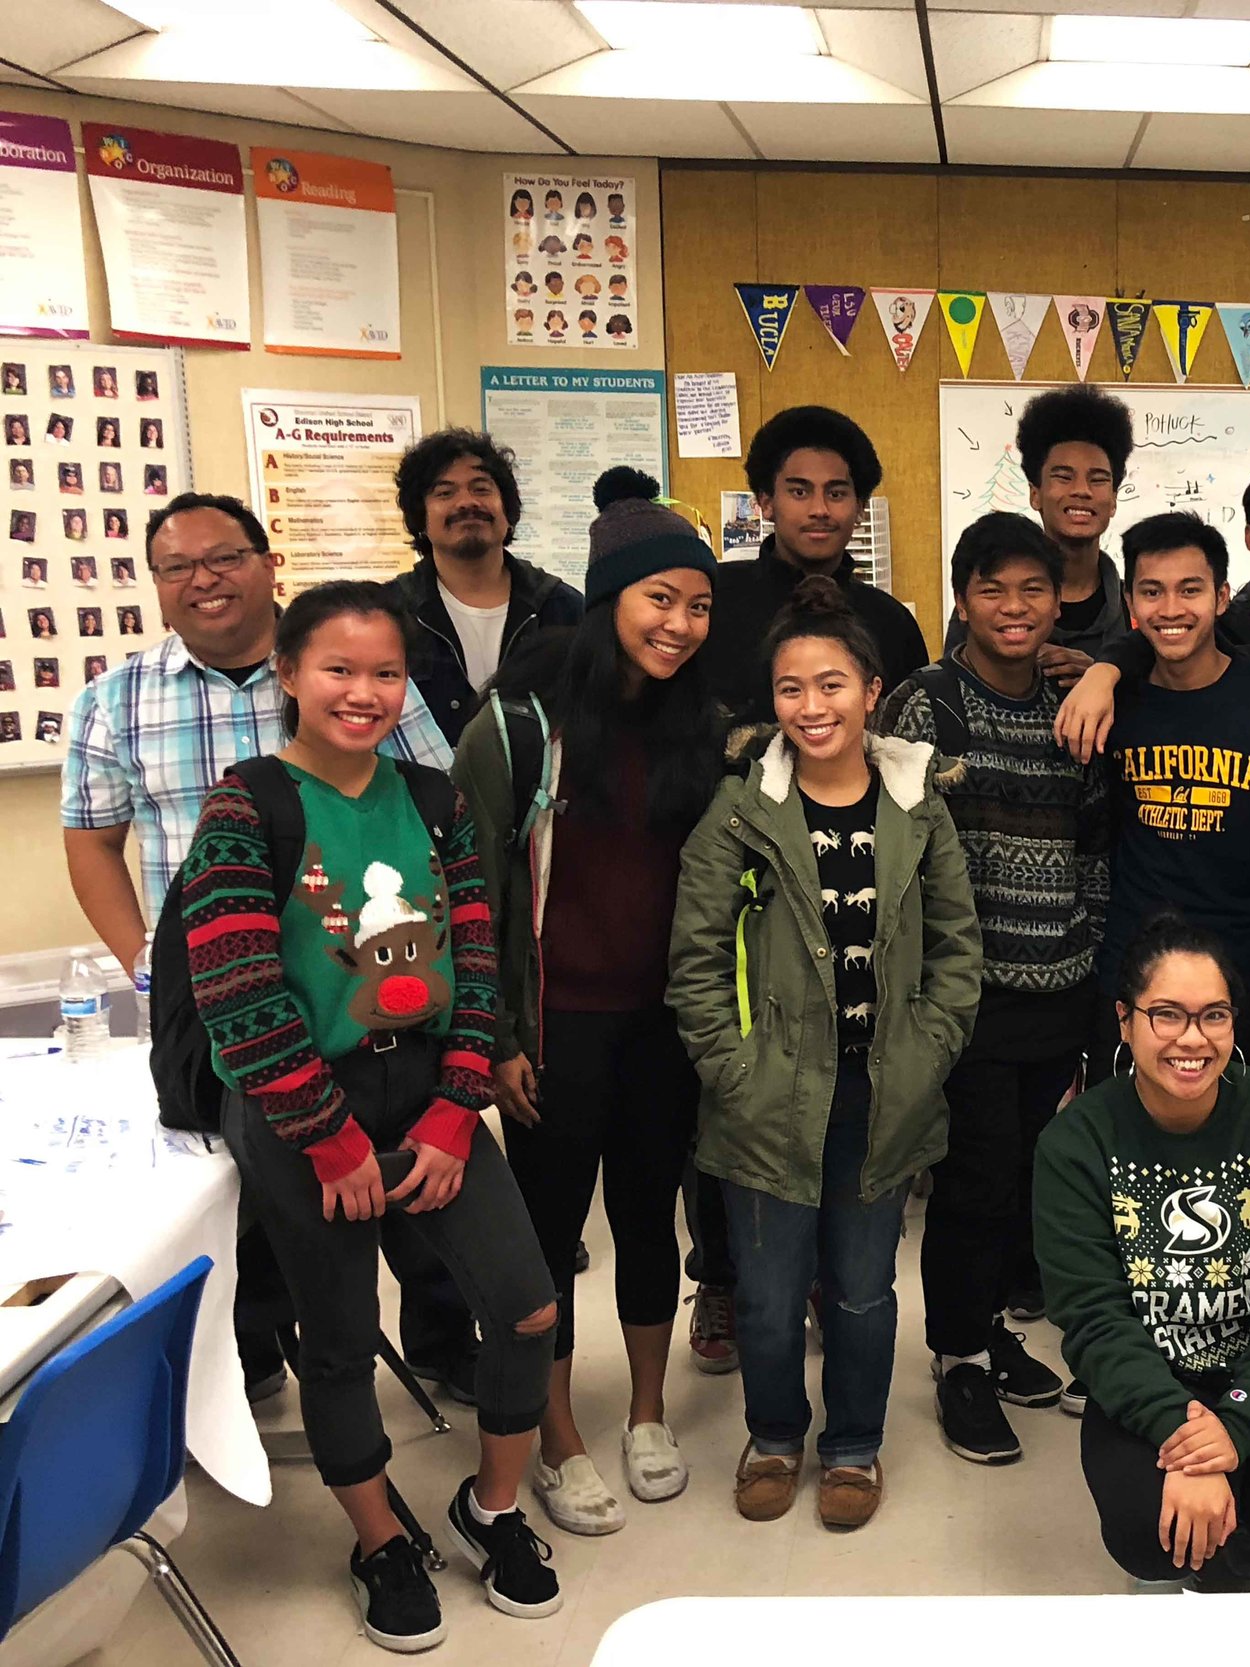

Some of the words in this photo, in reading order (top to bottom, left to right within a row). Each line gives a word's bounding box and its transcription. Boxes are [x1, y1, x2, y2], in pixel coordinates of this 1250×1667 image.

[137, 158, 234, 185] Organization
[514, 176, 535, 186] How
[538, 177, 551, 186] Do
[552, 178, 570, 188] You
[572, 178, 590, 188] Feel
[593, 180, 624, 190] Today?
[301, 181, 357, 205] Reading
[843, 292, 856, 318] LSU
[1114, 302, 1145, 338] SANTA
[757, 312, 778, 356] UCLA
[490, 375, 500, 385] A
[502, 375, 549, 387] LETTER
[552, 376, 568, 387] TO
[572, 376, 589, 387] MY
[593, 377, 655, 389] STUDENTS
[295, 417, 323, 426] Edison
[325, 418, 344, 428] High
[346, 419, 374, 427] School
[275, 428, 301, 441] A-G
[305, 429, 394, 444] Requirements
[265, 454, 279, 469] A
[269, 489, 280, 503] B
[271, 519, 283, 534] C
[271, 552, 286, 567] D
[277, 582, 286, 597] E
[1137, 788, 1152, 799] EST
[1172, 785, 1190, 803] Cal
[1138, 804, 1188, 830] ATHLETIC
[1190, 808, 1226, 832] DEPT.
